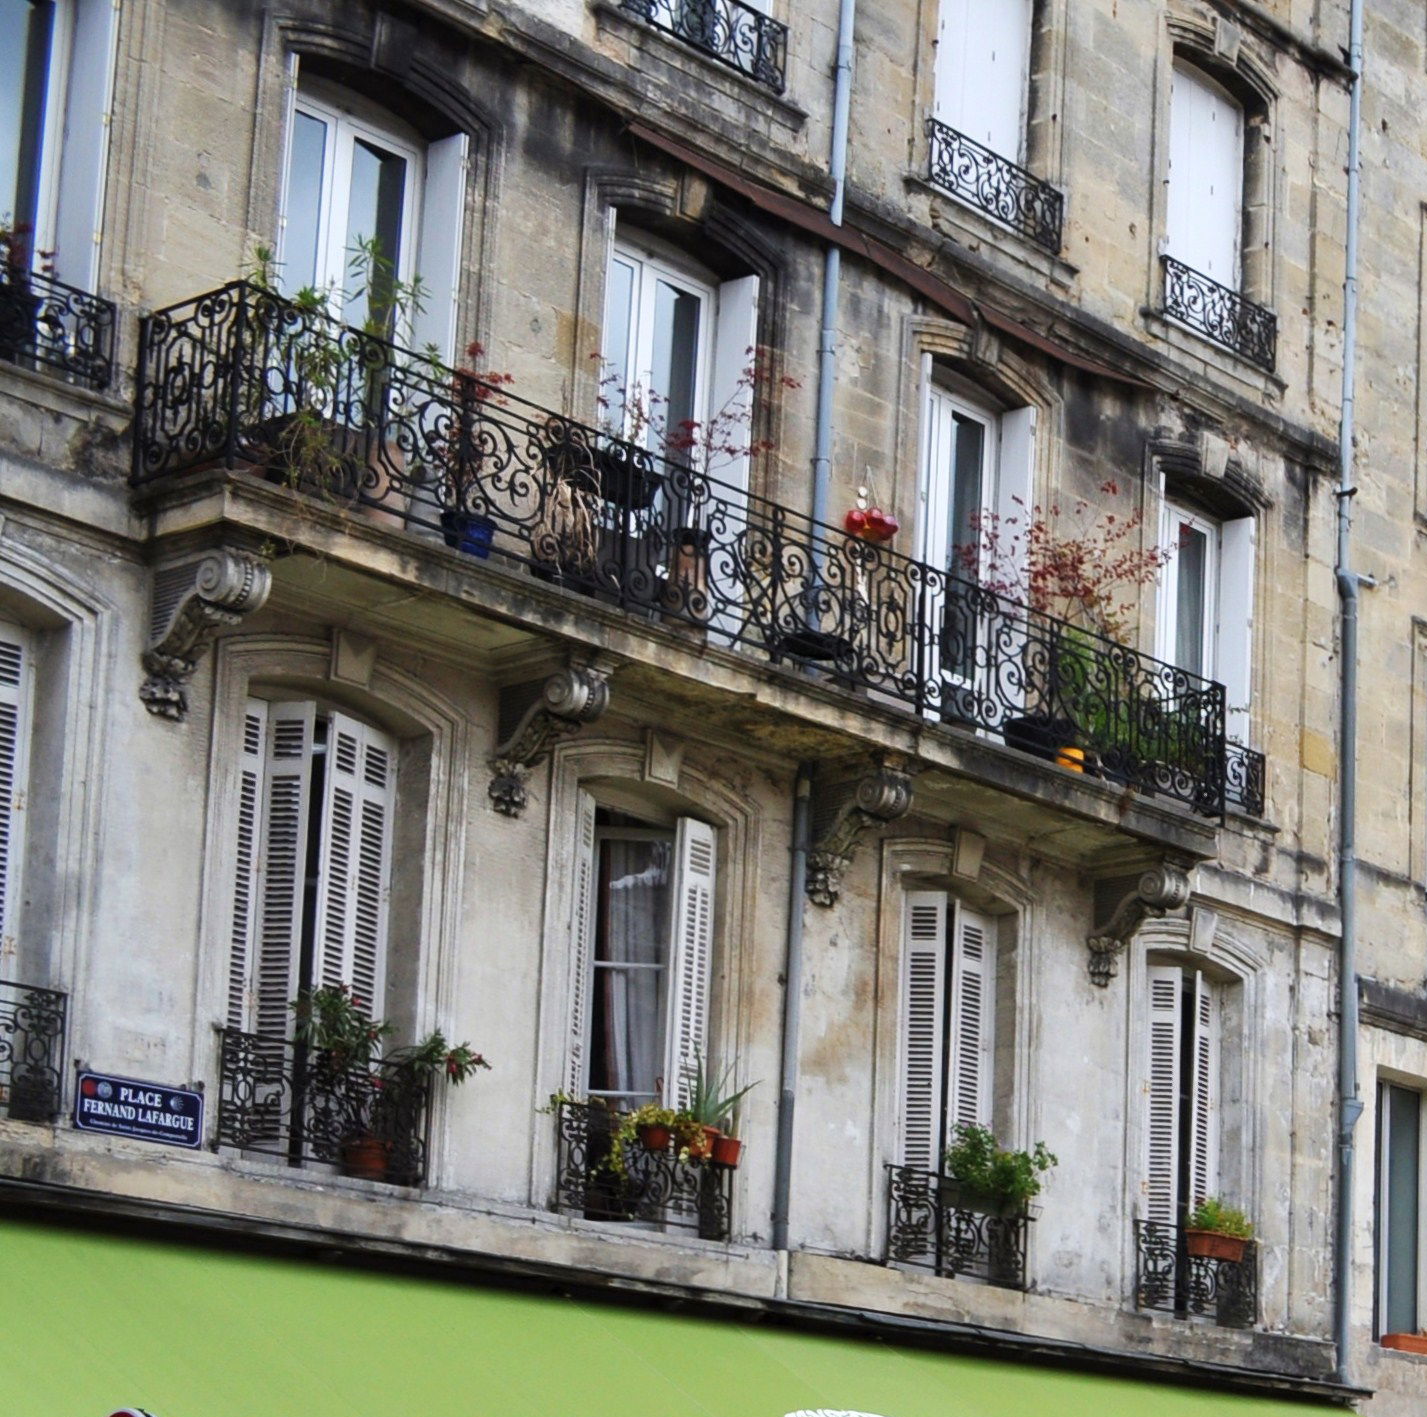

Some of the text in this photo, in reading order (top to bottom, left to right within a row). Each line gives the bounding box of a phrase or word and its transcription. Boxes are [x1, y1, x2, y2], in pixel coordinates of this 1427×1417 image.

[120, 1087, 162, 1108] PLACE
[83, 1099, 194, 1131] FERNAND LAFARGUE
